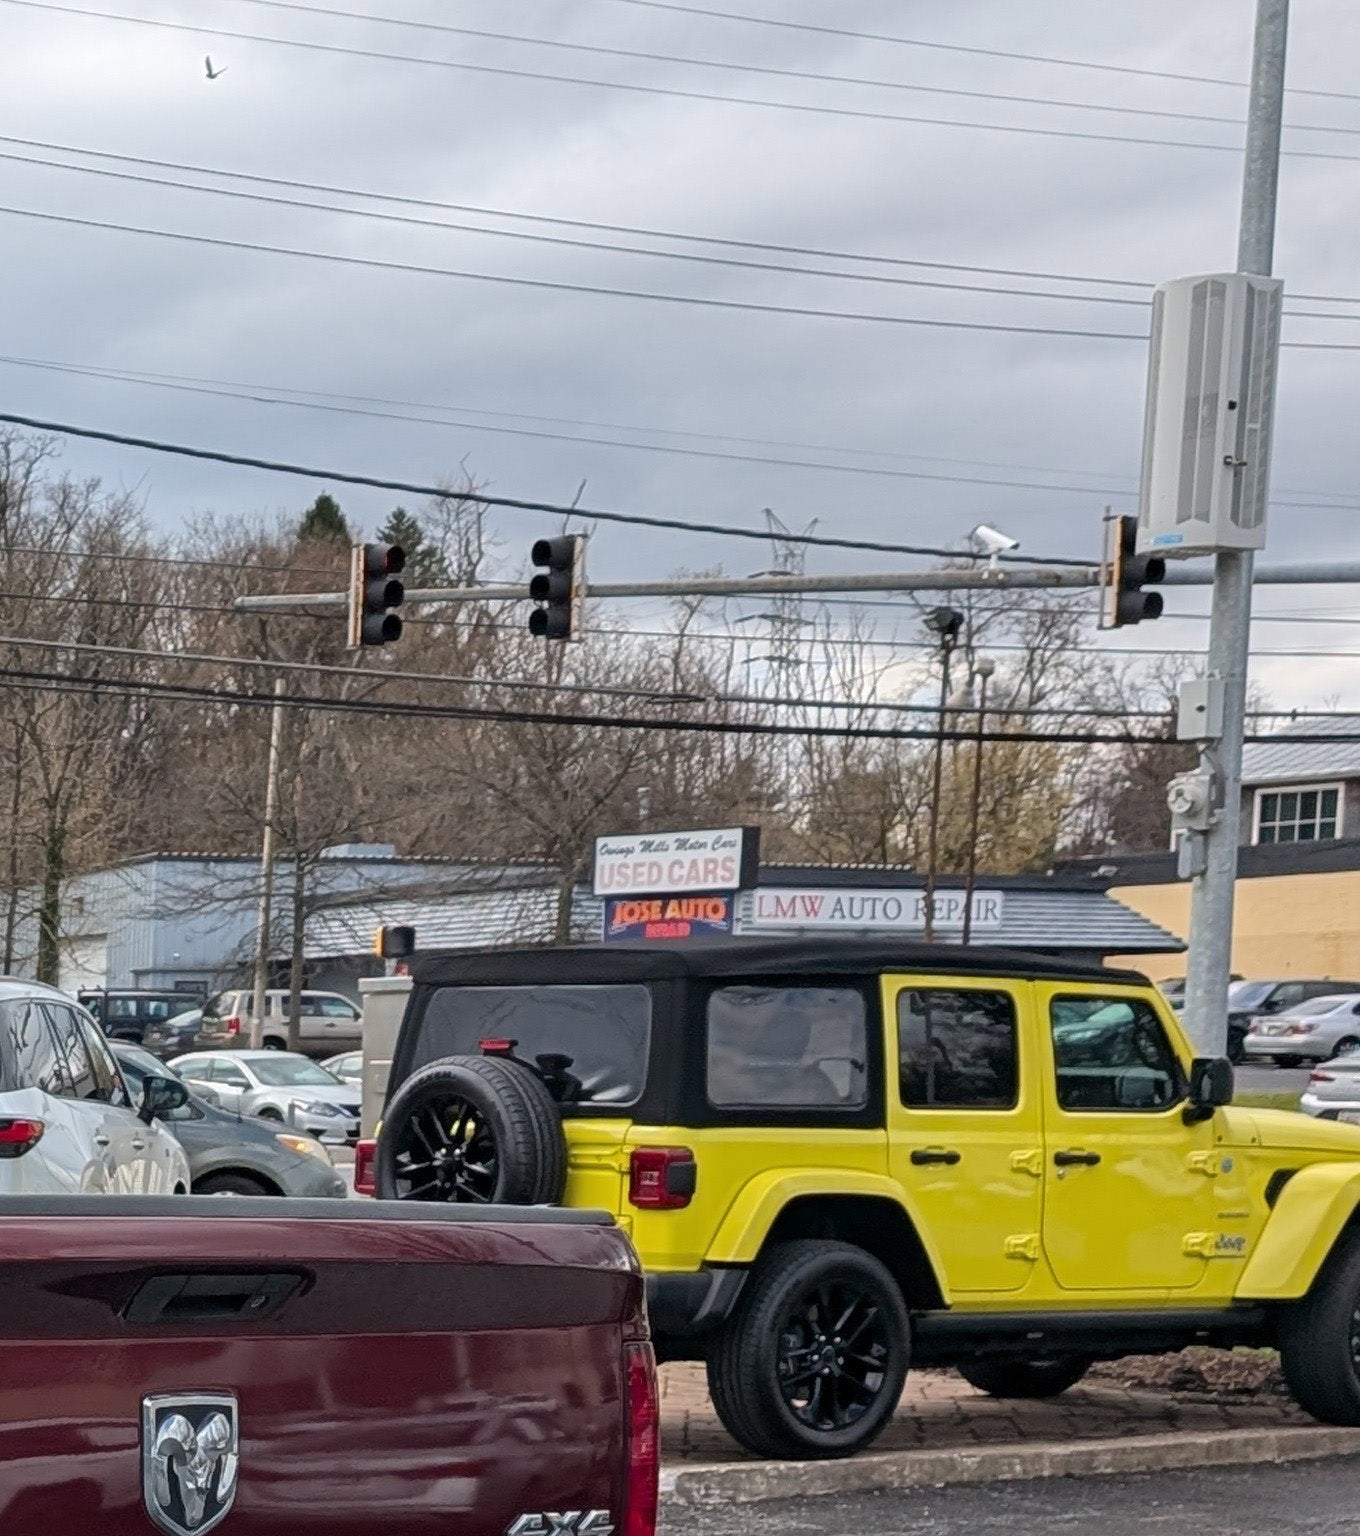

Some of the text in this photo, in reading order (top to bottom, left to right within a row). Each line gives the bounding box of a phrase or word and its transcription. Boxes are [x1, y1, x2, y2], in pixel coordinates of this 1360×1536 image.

[599, 842, 636, 858] Owings
[638, 839, 670, 853] Mills
[711, 834, 737, 850] Cars
[598, 854, 736, 889] USED CARS
[612, 896, 726, 925] JOSE AUTO
[757, 894, 825, 918] LMW
[829, 896, 903, 920] AUTO
